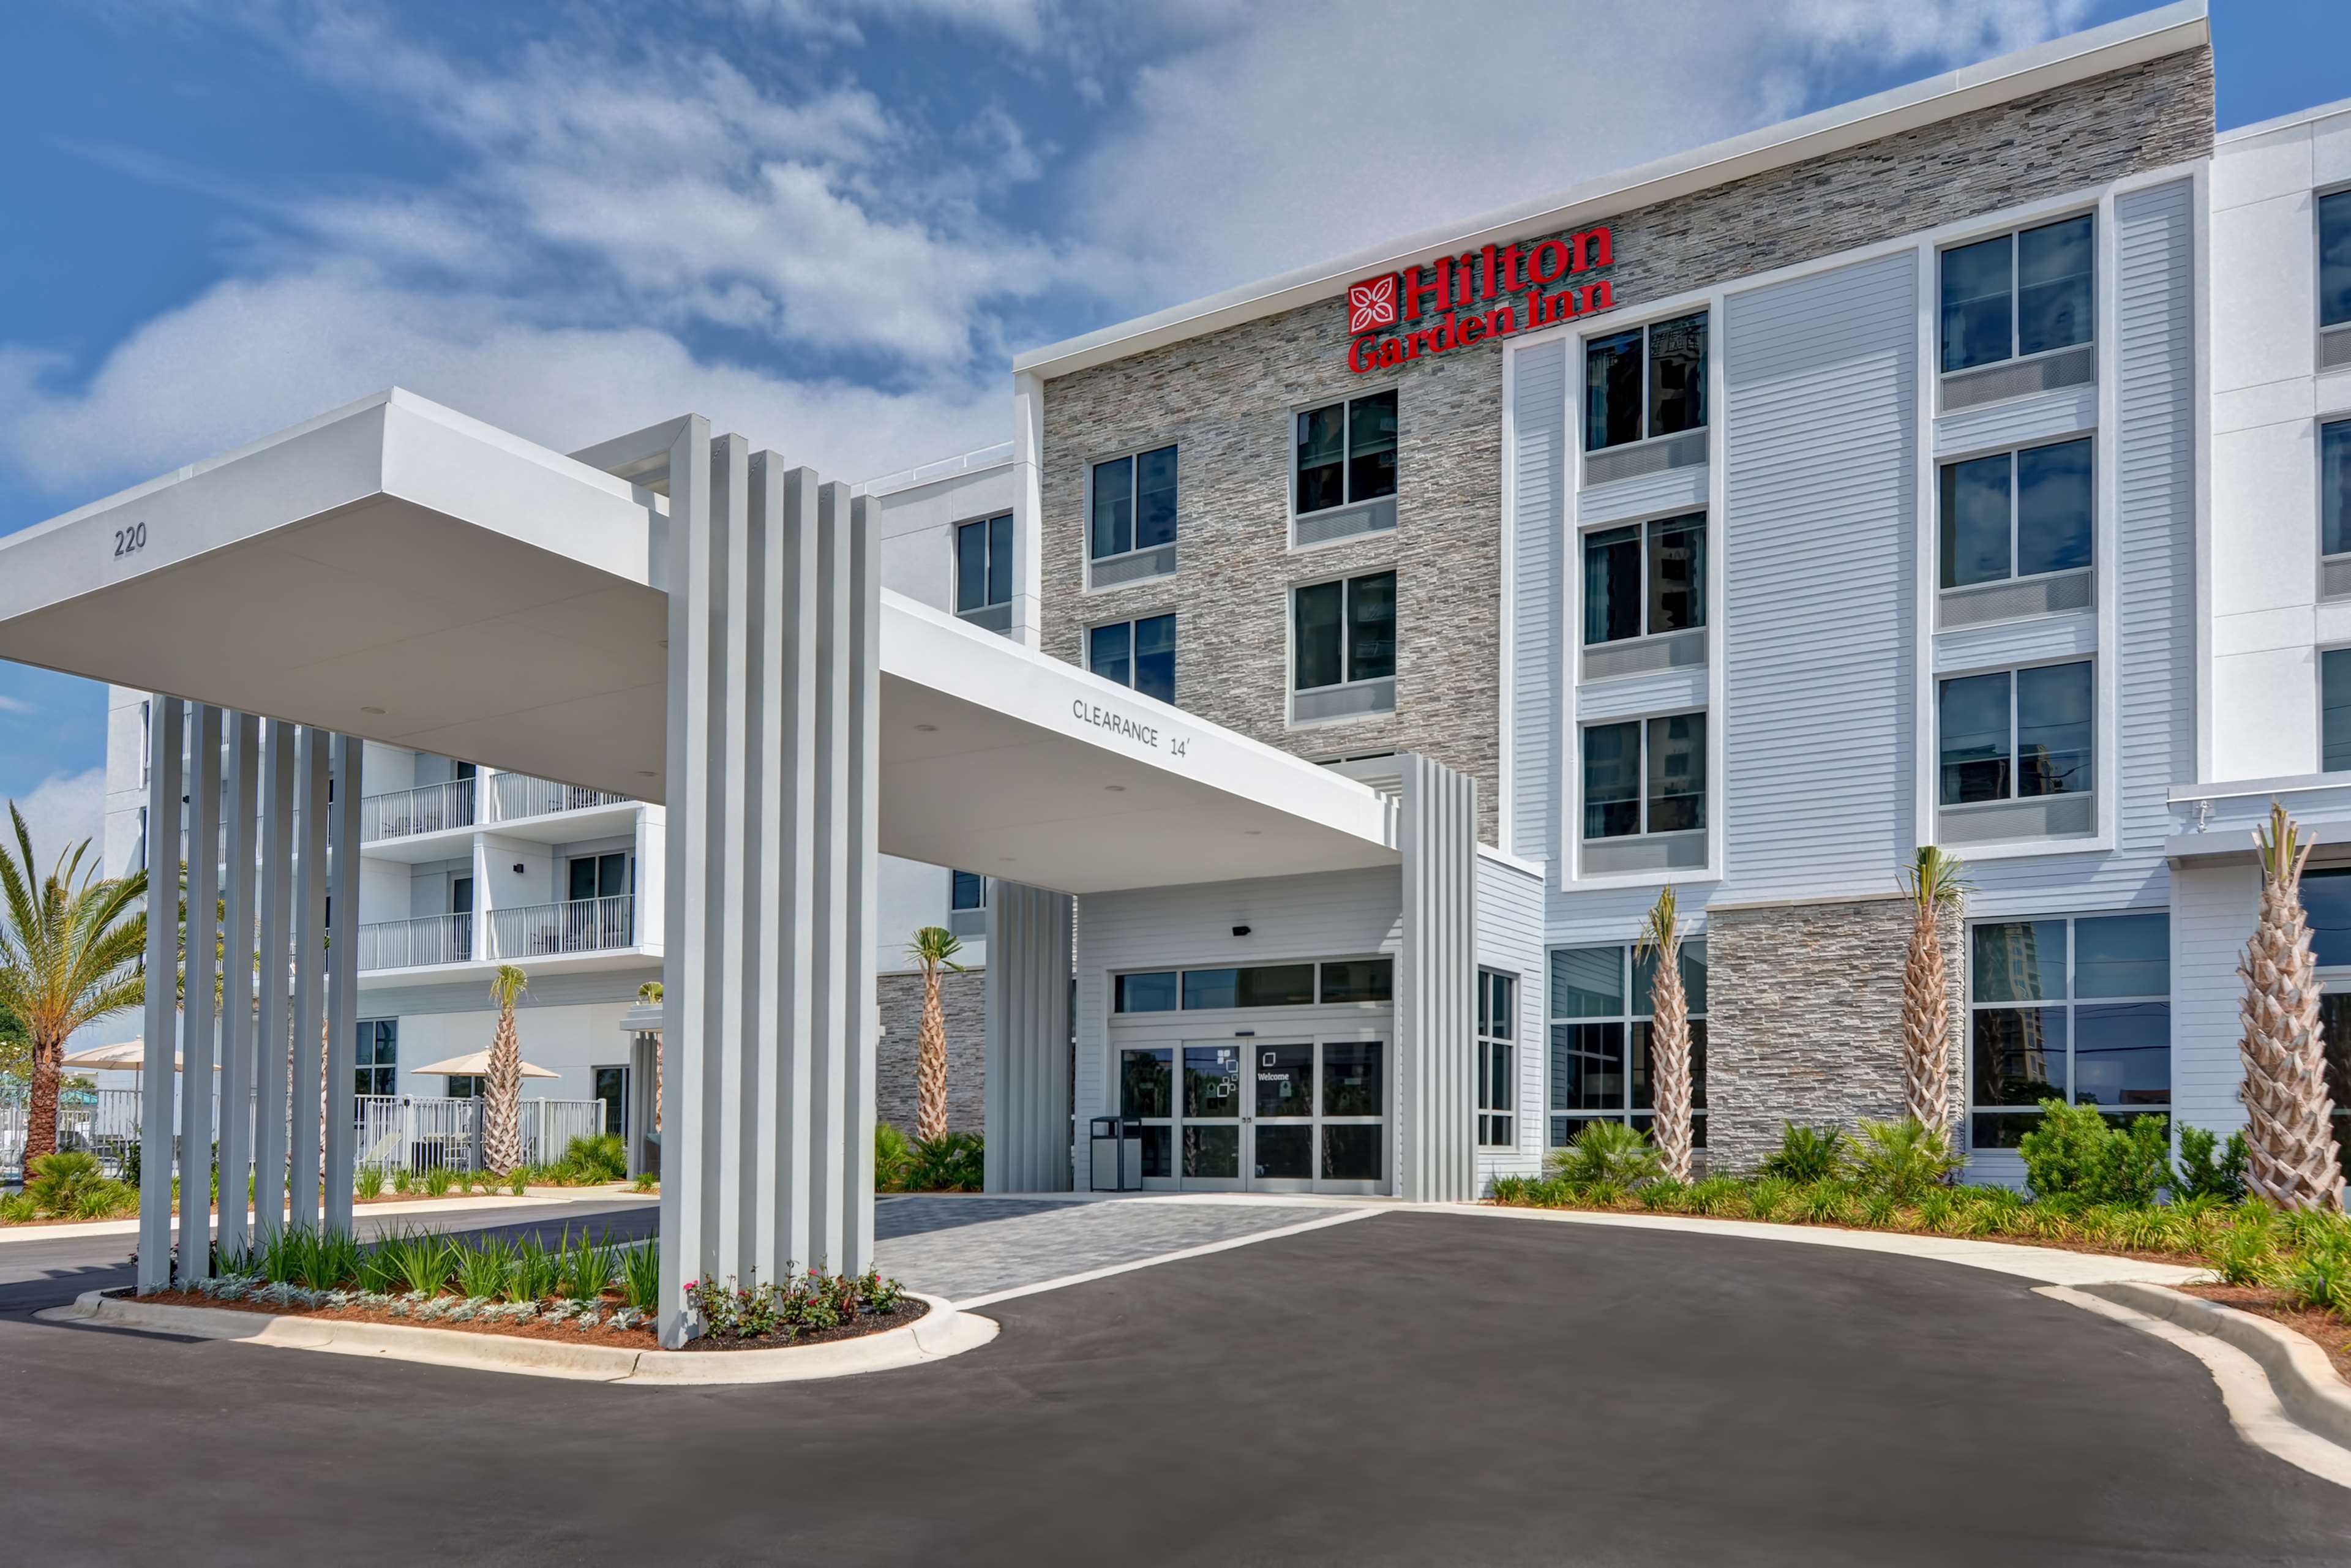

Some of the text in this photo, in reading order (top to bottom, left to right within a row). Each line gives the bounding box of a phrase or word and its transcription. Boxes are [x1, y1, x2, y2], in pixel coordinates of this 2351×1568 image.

[1403, 227, 1614, 321] Hilton
[1348, 280, 1616, 373] Garden Inn
[114, 522, 146, 556] 220
[1073, 699, 1190, 758] CLEARANCE 14'
[1258, 1073, 1289, 1081] Welcome
